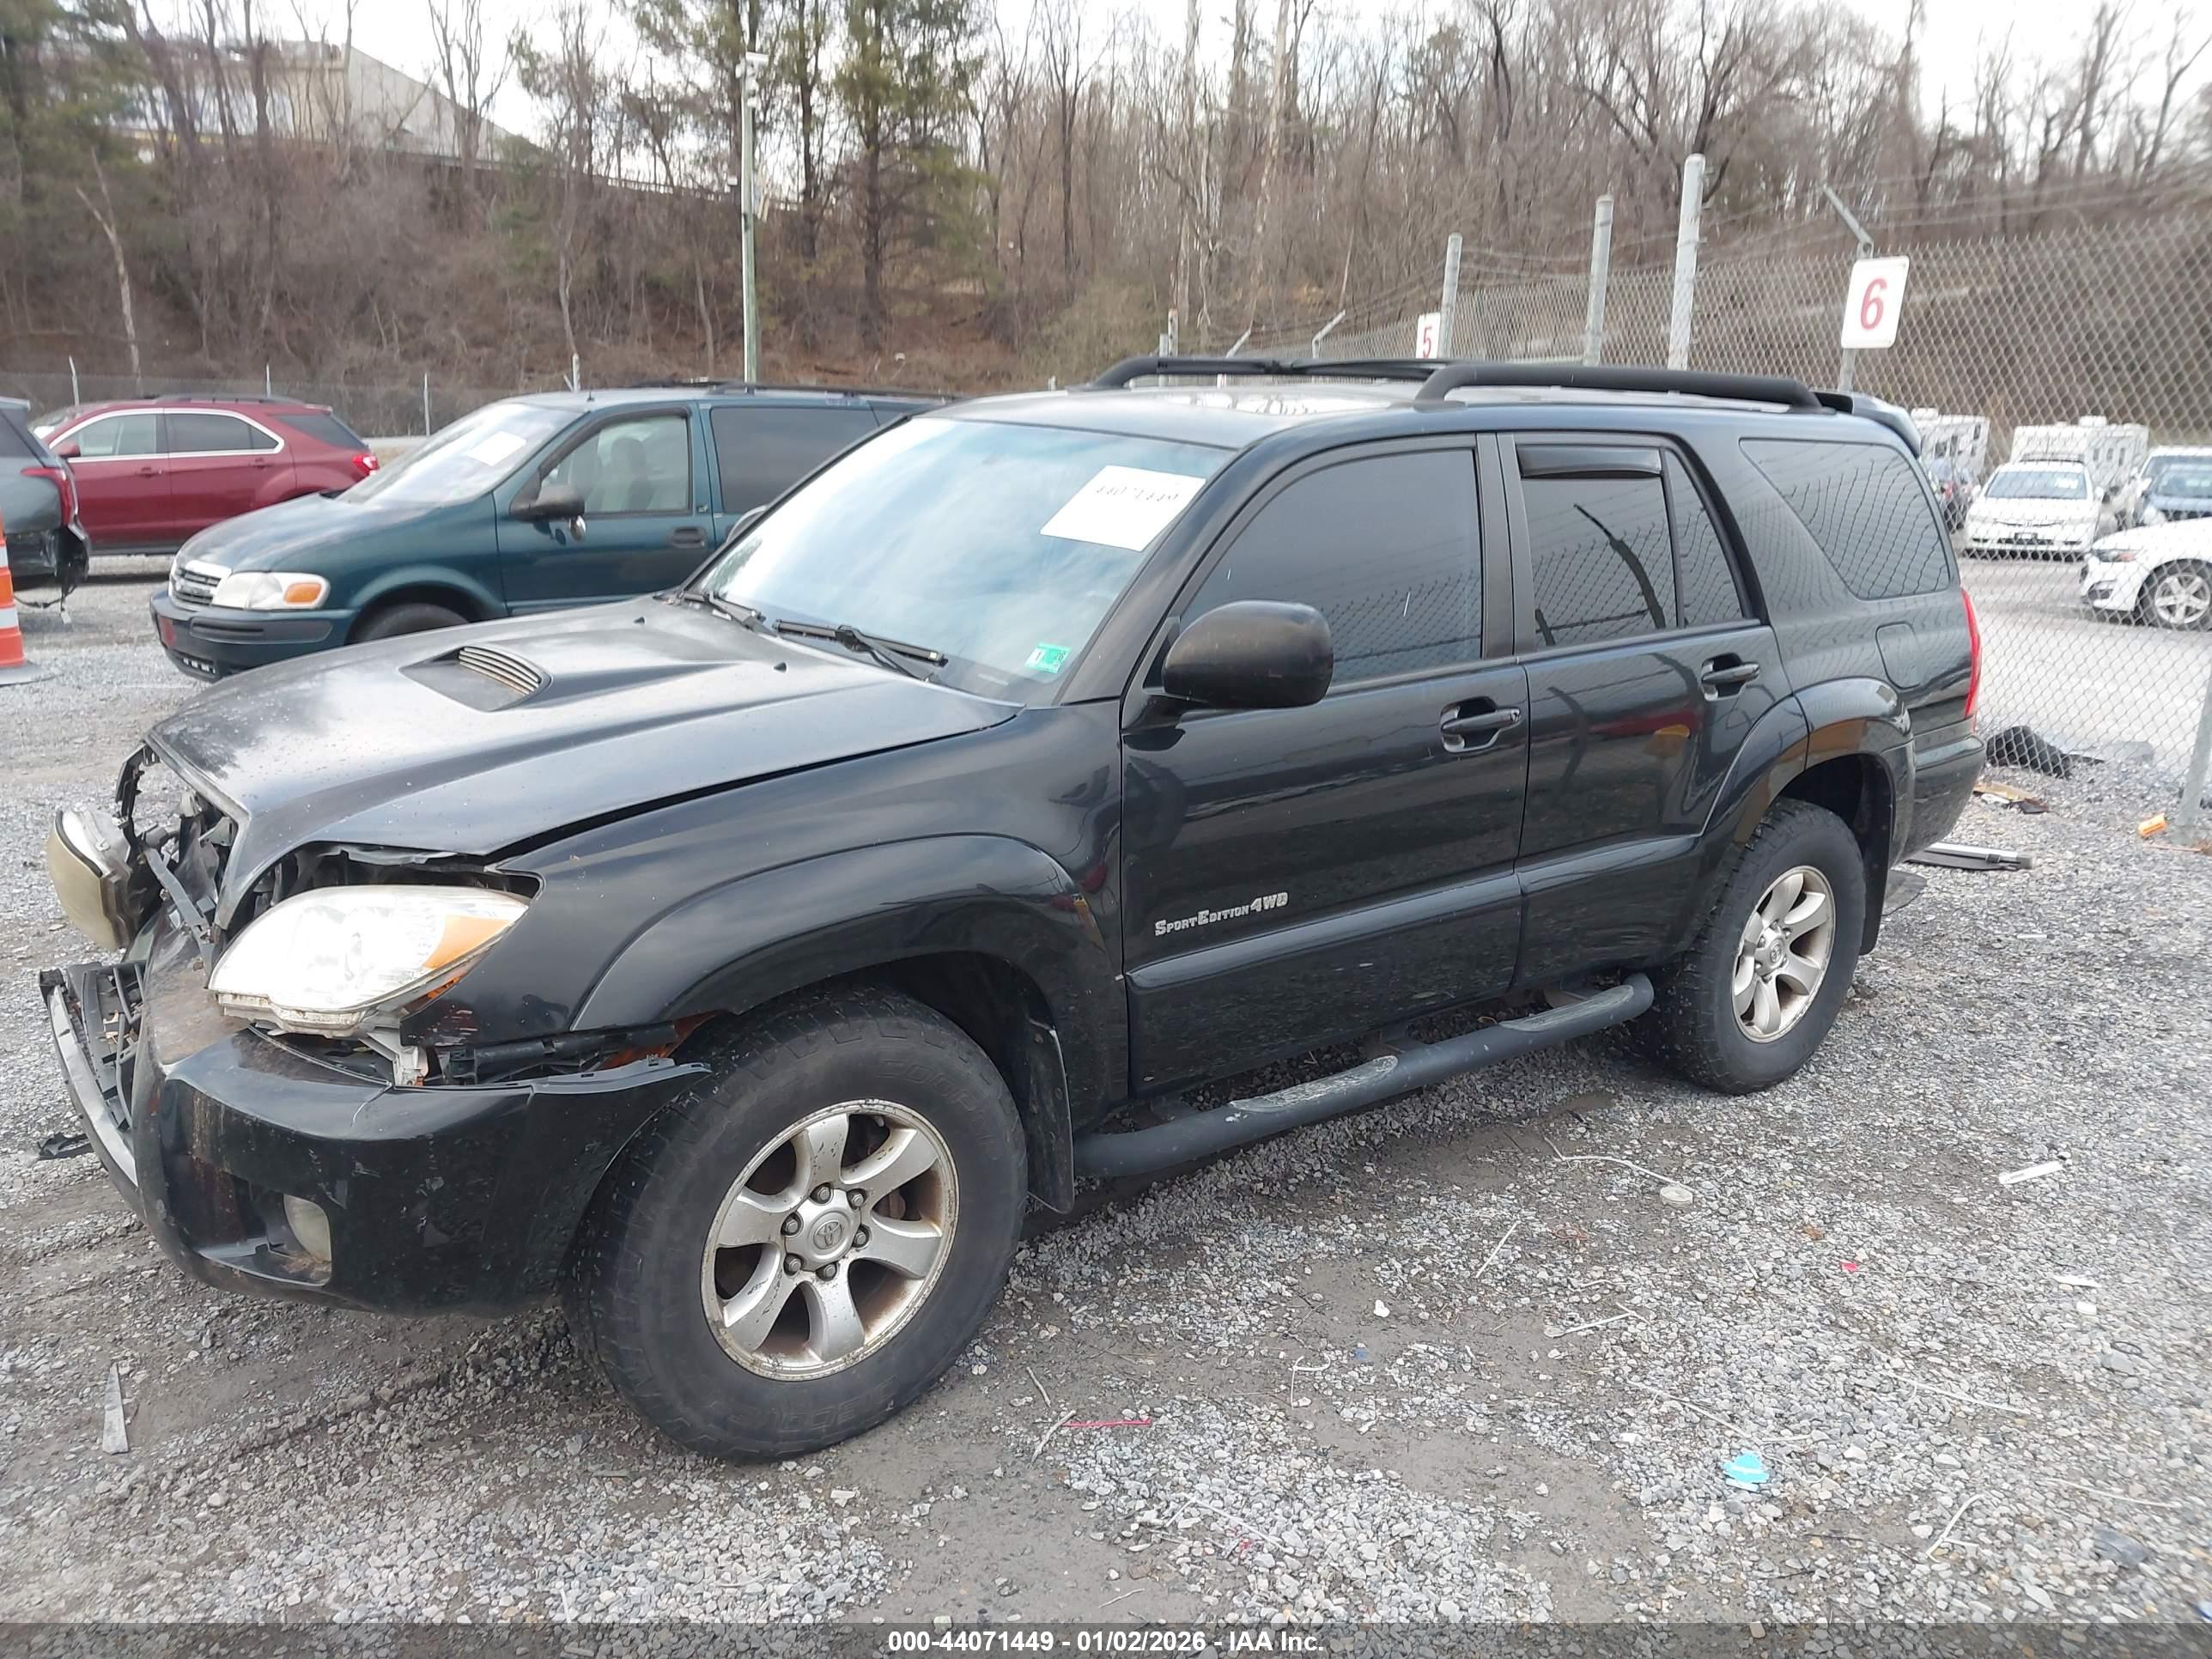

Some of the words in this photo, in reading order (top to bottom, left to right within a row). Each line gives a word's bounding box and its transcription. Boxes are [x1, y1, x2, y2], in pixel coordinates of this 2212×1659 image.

[1860, 277, 1887, 331] 6
[1422, 325, 1432, 359] 5
[1249, 891, 1289, 913] 4WD
